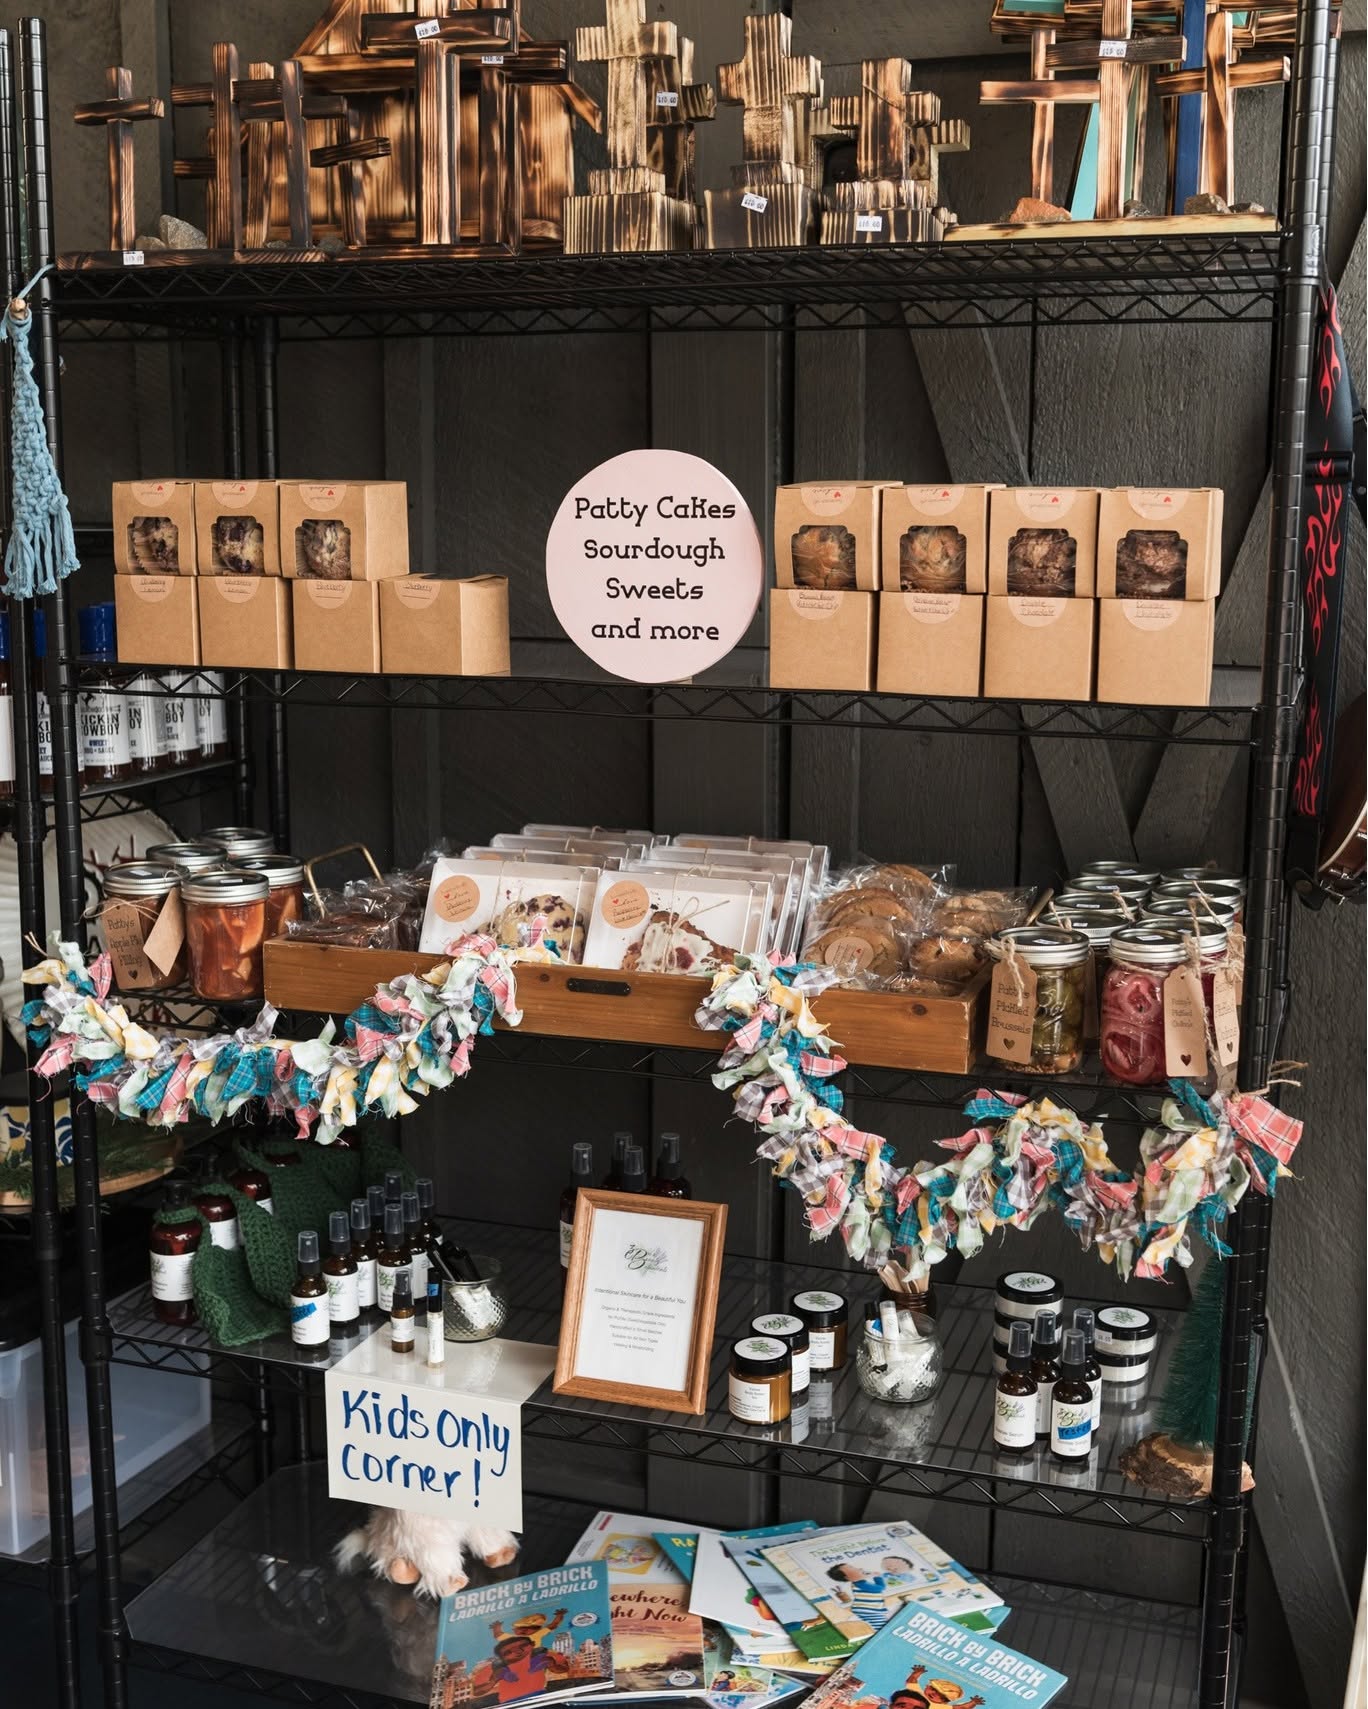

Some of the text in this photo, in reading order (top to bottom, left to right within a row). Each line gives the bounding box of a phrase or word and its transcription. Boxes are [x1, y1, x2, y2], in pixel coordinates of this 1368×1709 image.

[574, 497, 649, 527] Patty
[584, 537, 726, 567] Sourdough
[606, 577, 704, 600] Sweets
[592, 617, 719, 641] and more
[107, 915, 136, 932] Patty's
[991, 1016, 1032, 1035] Brussels
[342, 1389, 510, 1477] Kids Only
[821, 1544, 891, 1564] the Dentist
[448, 1597, 515, 1623] LADRILLO
[517, 1594, 528, 1604] A
[531, 1579, 599, 1602] LADRILLO
[455, 1585, 510, 1610] BRICK
[537, 1566, 593, 1589] BRICK
[641, 1607, 688, 1623] Now
[891, 1626, 960, 1661] LADRILLO
[956, 1657, 971, 1667] A
[969, 1662, 1039, 1701] LADRILLO
[907, 1611, 970, 1648] BRICK
[985, 1649, 1048, 1687] BRICK
